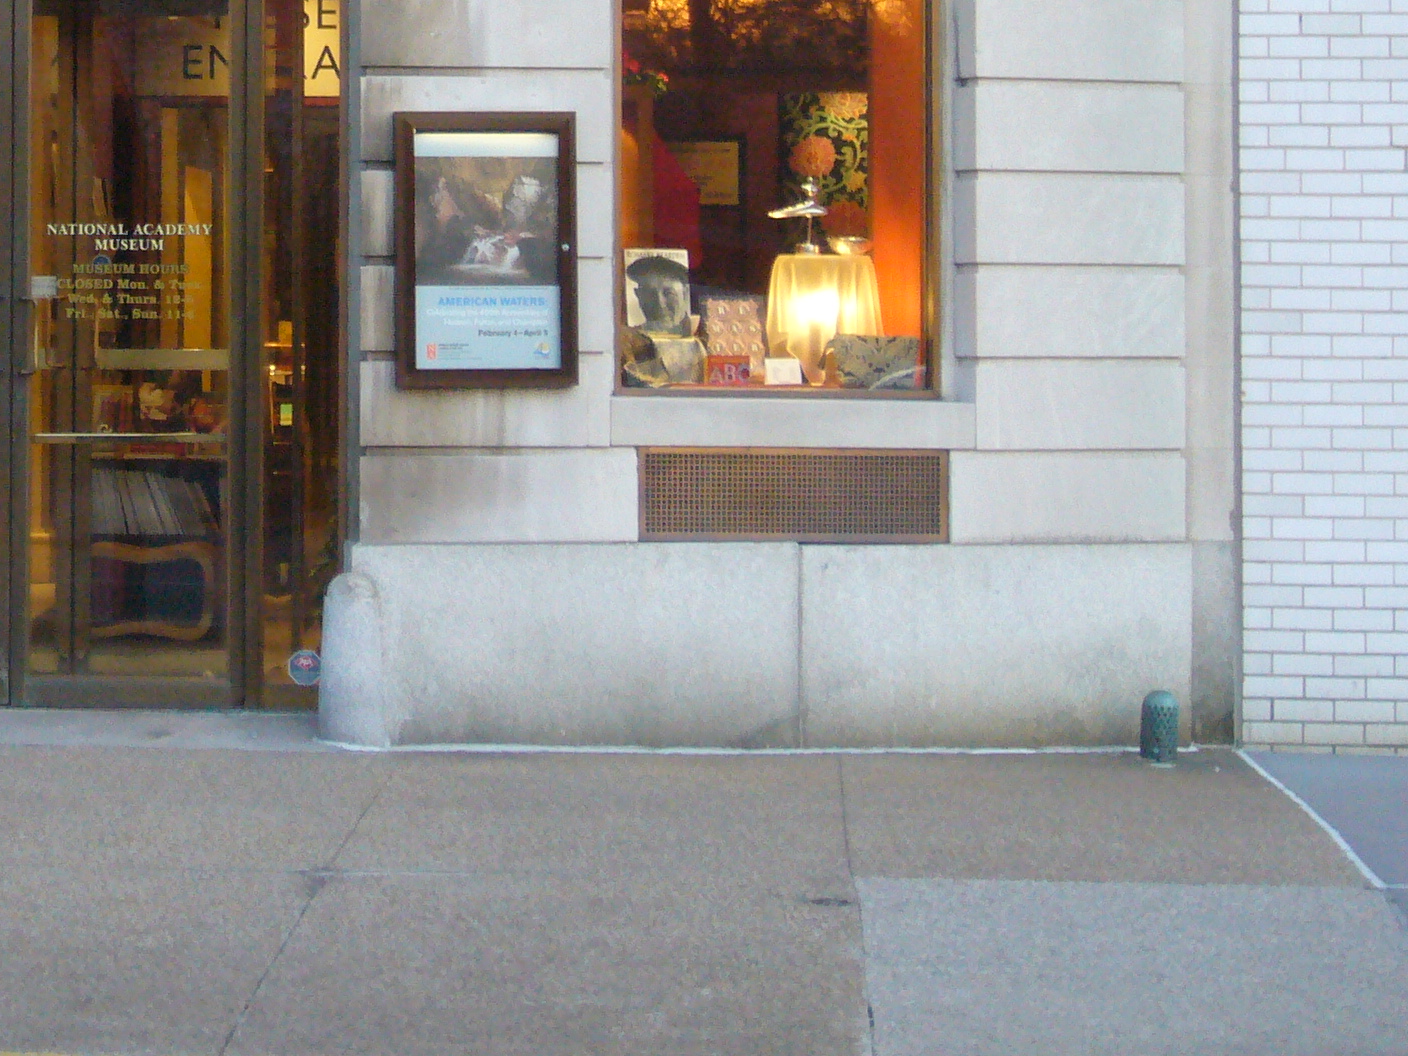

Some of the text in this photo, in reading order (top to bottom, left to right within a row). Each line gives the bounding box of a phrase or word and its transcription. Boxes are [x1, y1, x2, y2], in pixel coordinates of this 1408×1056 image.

[46, 223, 213, 236] NATIONAL ACADEMY
[94, 238, 165, 251] MUSEUM
[72, 263, 189, 275] MUSEUM HOURS
[57, 278, 114, 290] CLOSED
[438, 296, 497, 306] AMERICAN
[709, 363, 751, 386] ABC
